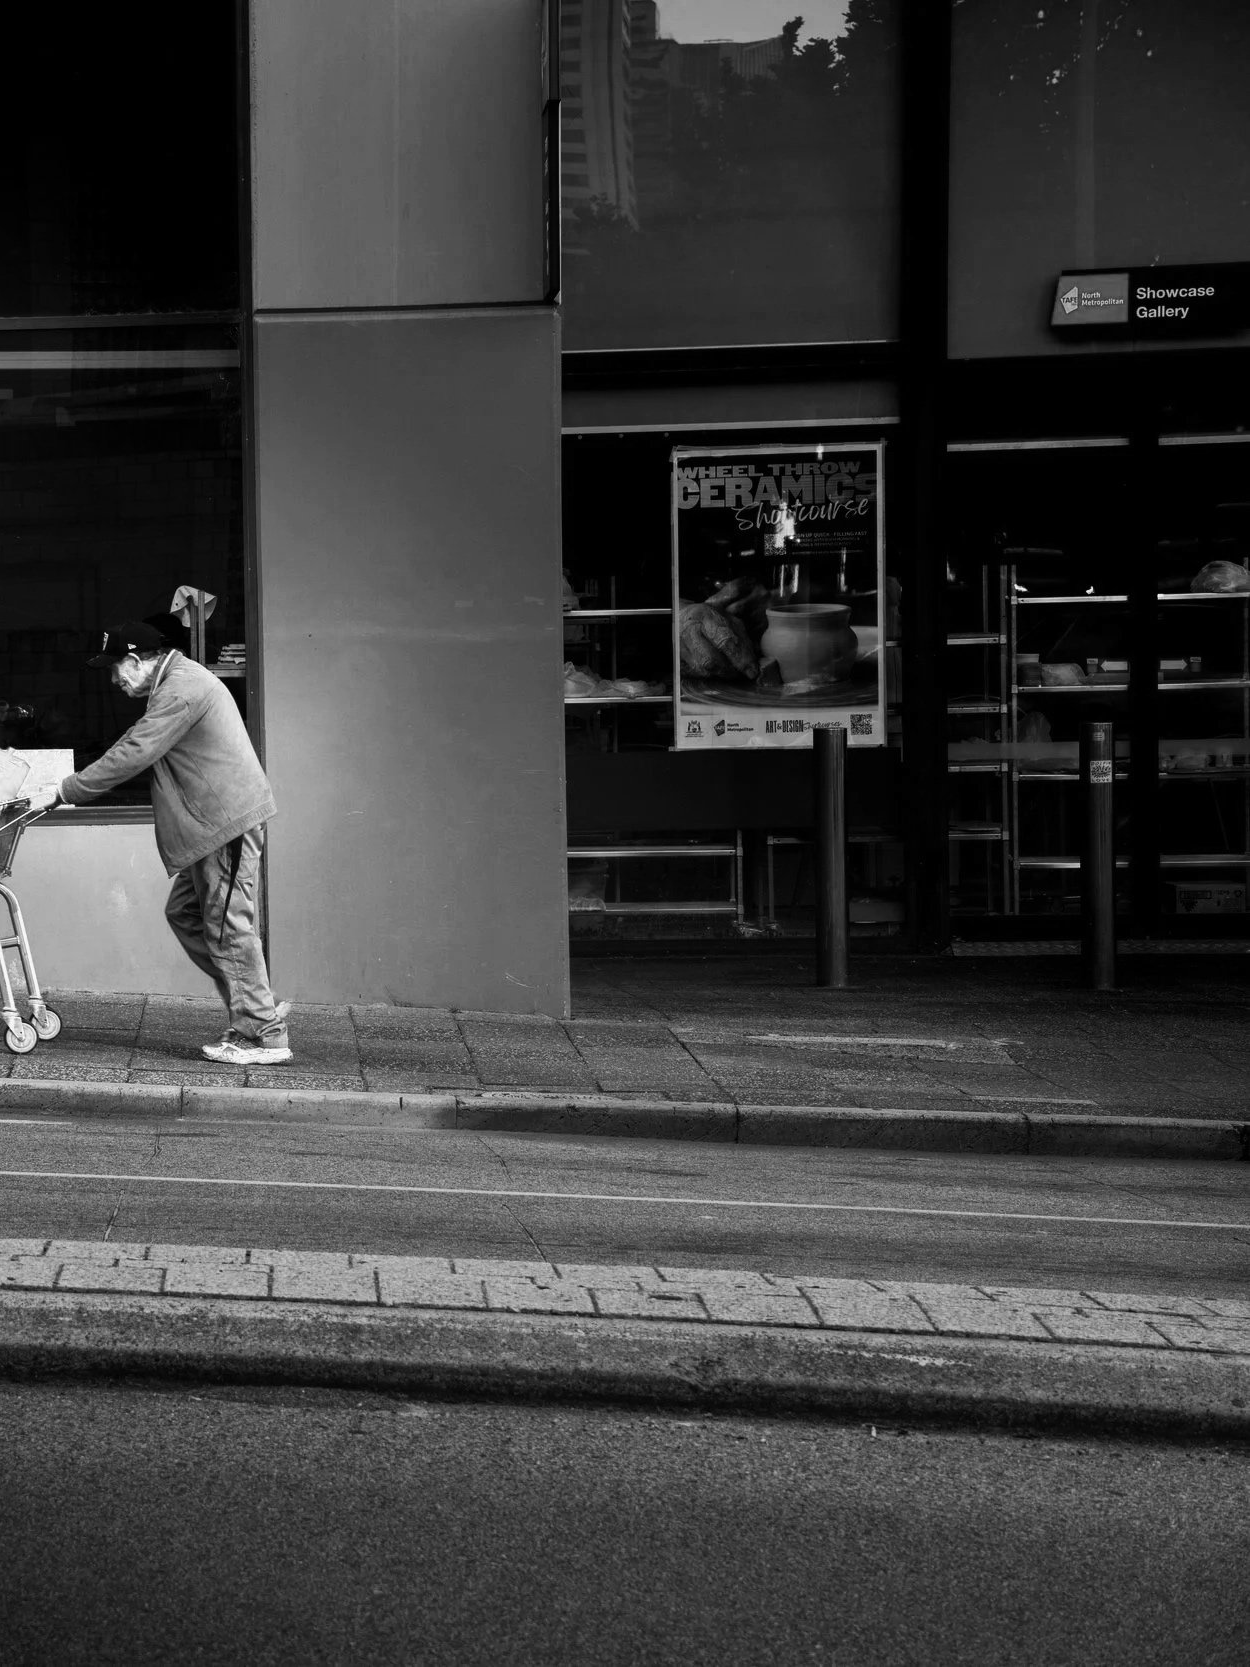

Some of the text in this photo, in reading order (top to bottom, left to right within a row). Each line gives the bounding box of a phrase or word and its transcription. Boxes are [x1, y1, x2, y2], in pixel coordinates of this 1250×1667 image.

[1081, 291, 1101, 299] North
[1135, 286, 1215, 300] Showcase
[1081, 298, 1124, 307] Metropolitan
[1135, 306, 1189, 319] Gallery
[678, 461, 862, 480] WHEEL THROW
[678, 472, 877, 509] CERAMICS
